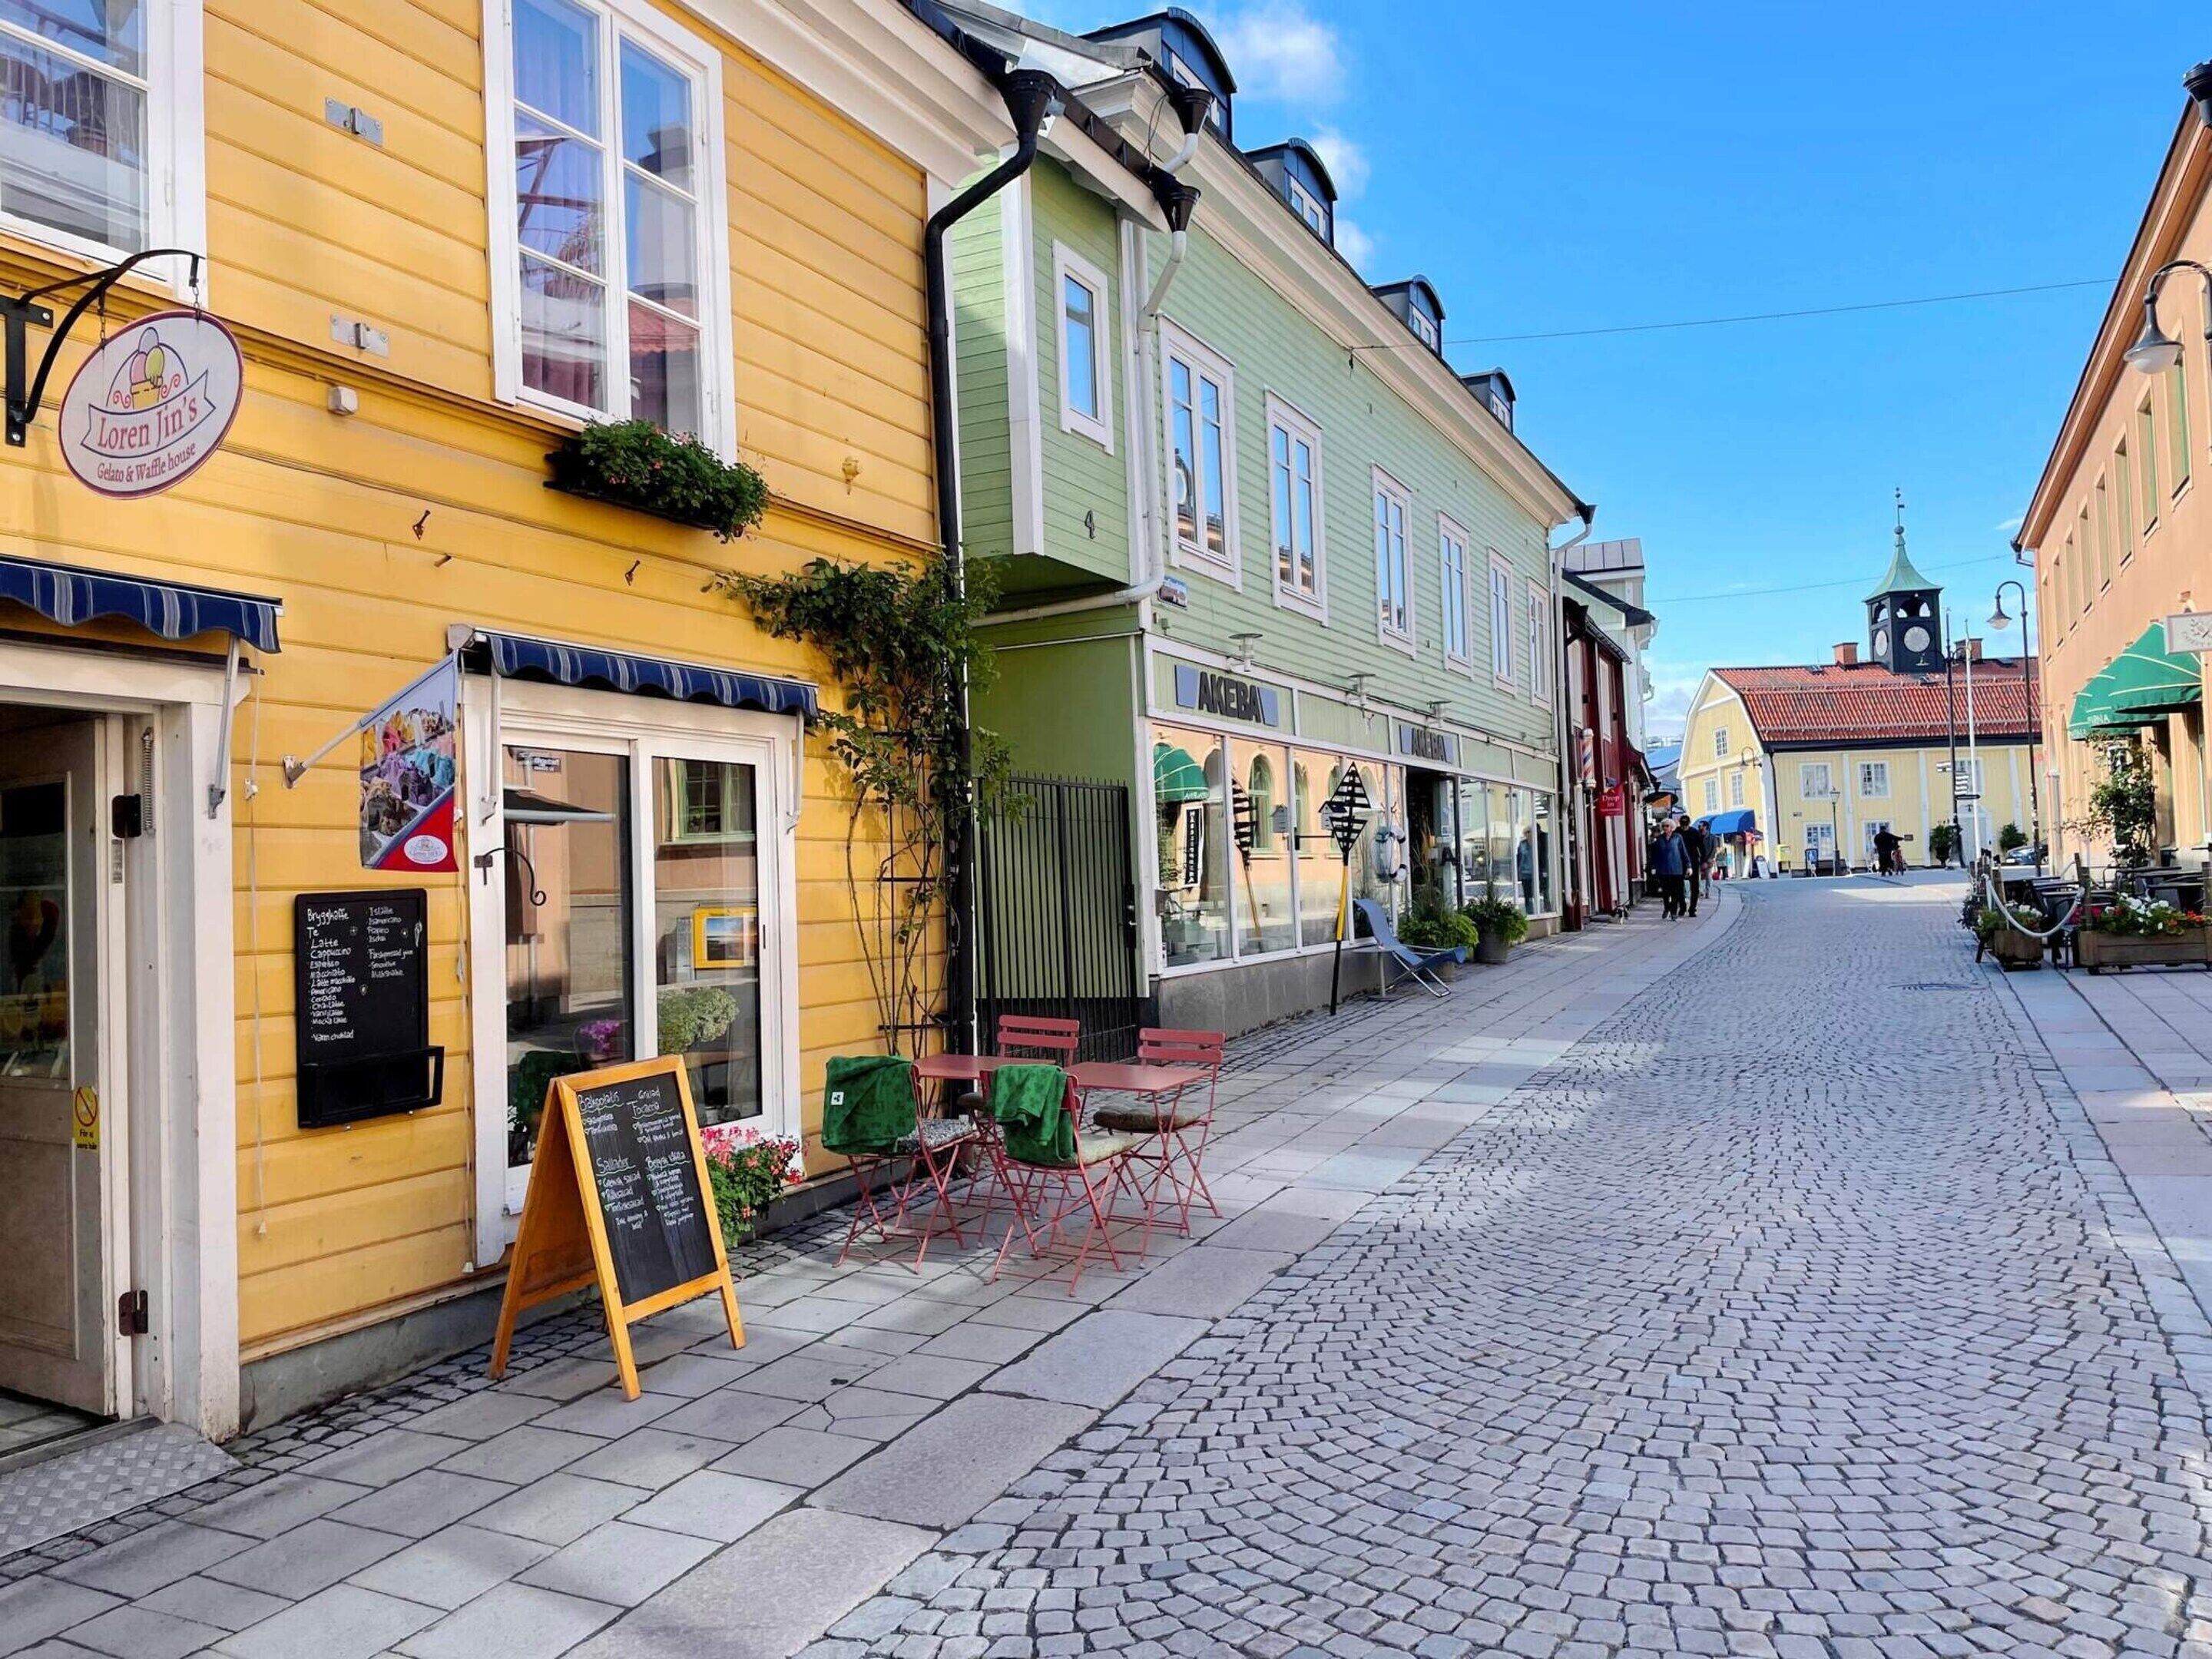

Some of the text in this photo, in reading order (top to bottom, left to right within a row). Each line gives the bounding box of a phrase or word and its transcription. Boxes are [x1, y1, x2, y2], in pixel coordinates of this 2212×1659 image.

[98, 396, 197, 450] Loren Jin's
[98, 442, 196, 482] Gelato & Waffle house
[1084, 509, 1095, 539] 4
[1198, 671, 1261, 723] AKEBA
[1412, 728, 1445, 761] AKEBA
[306, 926, 319, 939] Te
[311, 938, 339, 949] Latte
